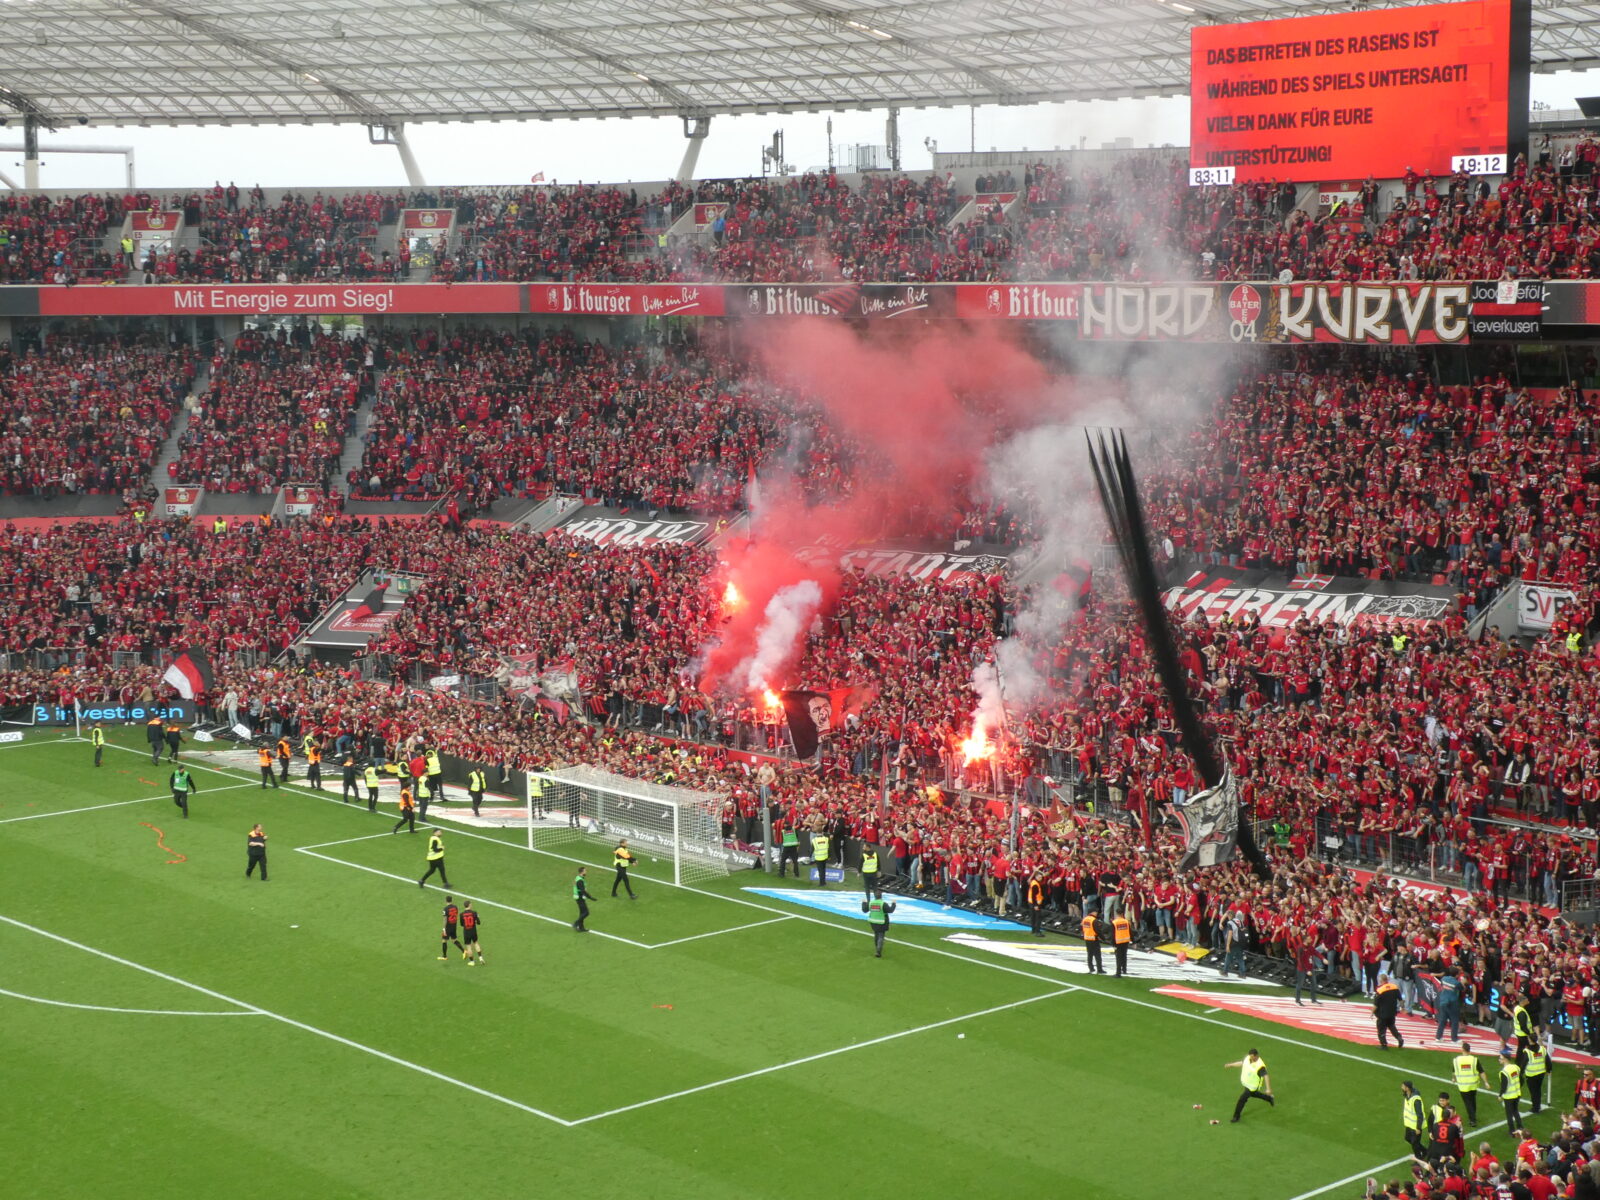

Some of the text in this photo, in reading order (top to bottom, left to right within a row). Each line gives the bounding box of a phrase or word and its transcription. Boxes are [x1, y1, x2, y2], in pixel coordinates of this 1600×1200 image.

[1207, 29, 1440, 65] DAS BETRETEN DES RASENS IST
[1207, 64, 1468, 99] WÄHREND DES SPIELS UNTERSAGT!
[1207, 107, 1373, 133] VIELEN DANK FÜR EURE
[1206, 145, 1332, 167] UNTERSTÜTZUNG!
[1459, 157, 1501, 173] 19:12
[1194, 169, 1230, 184] 83:11
[174, 289, 393, 312] Mit Energie zum Sieg!
[643, 286, 699, 313] Bitte ein Bit
[861, 286, 928, 315] Bitte ein Bit
[1008, 286, 1078, 317] Bitbur
[1083, 287, 1214, 336] NORD
[1229, 300, 1259, 309] BAYER
[1279, 286, 1468, 341] KURVE
[1472, 319, 1539, 333] Leverkusen
[1229, 320, 1257, 342] 04
[1165, 588, 1375, 627] VEREIN
[738, 855, 755, 866] trive
